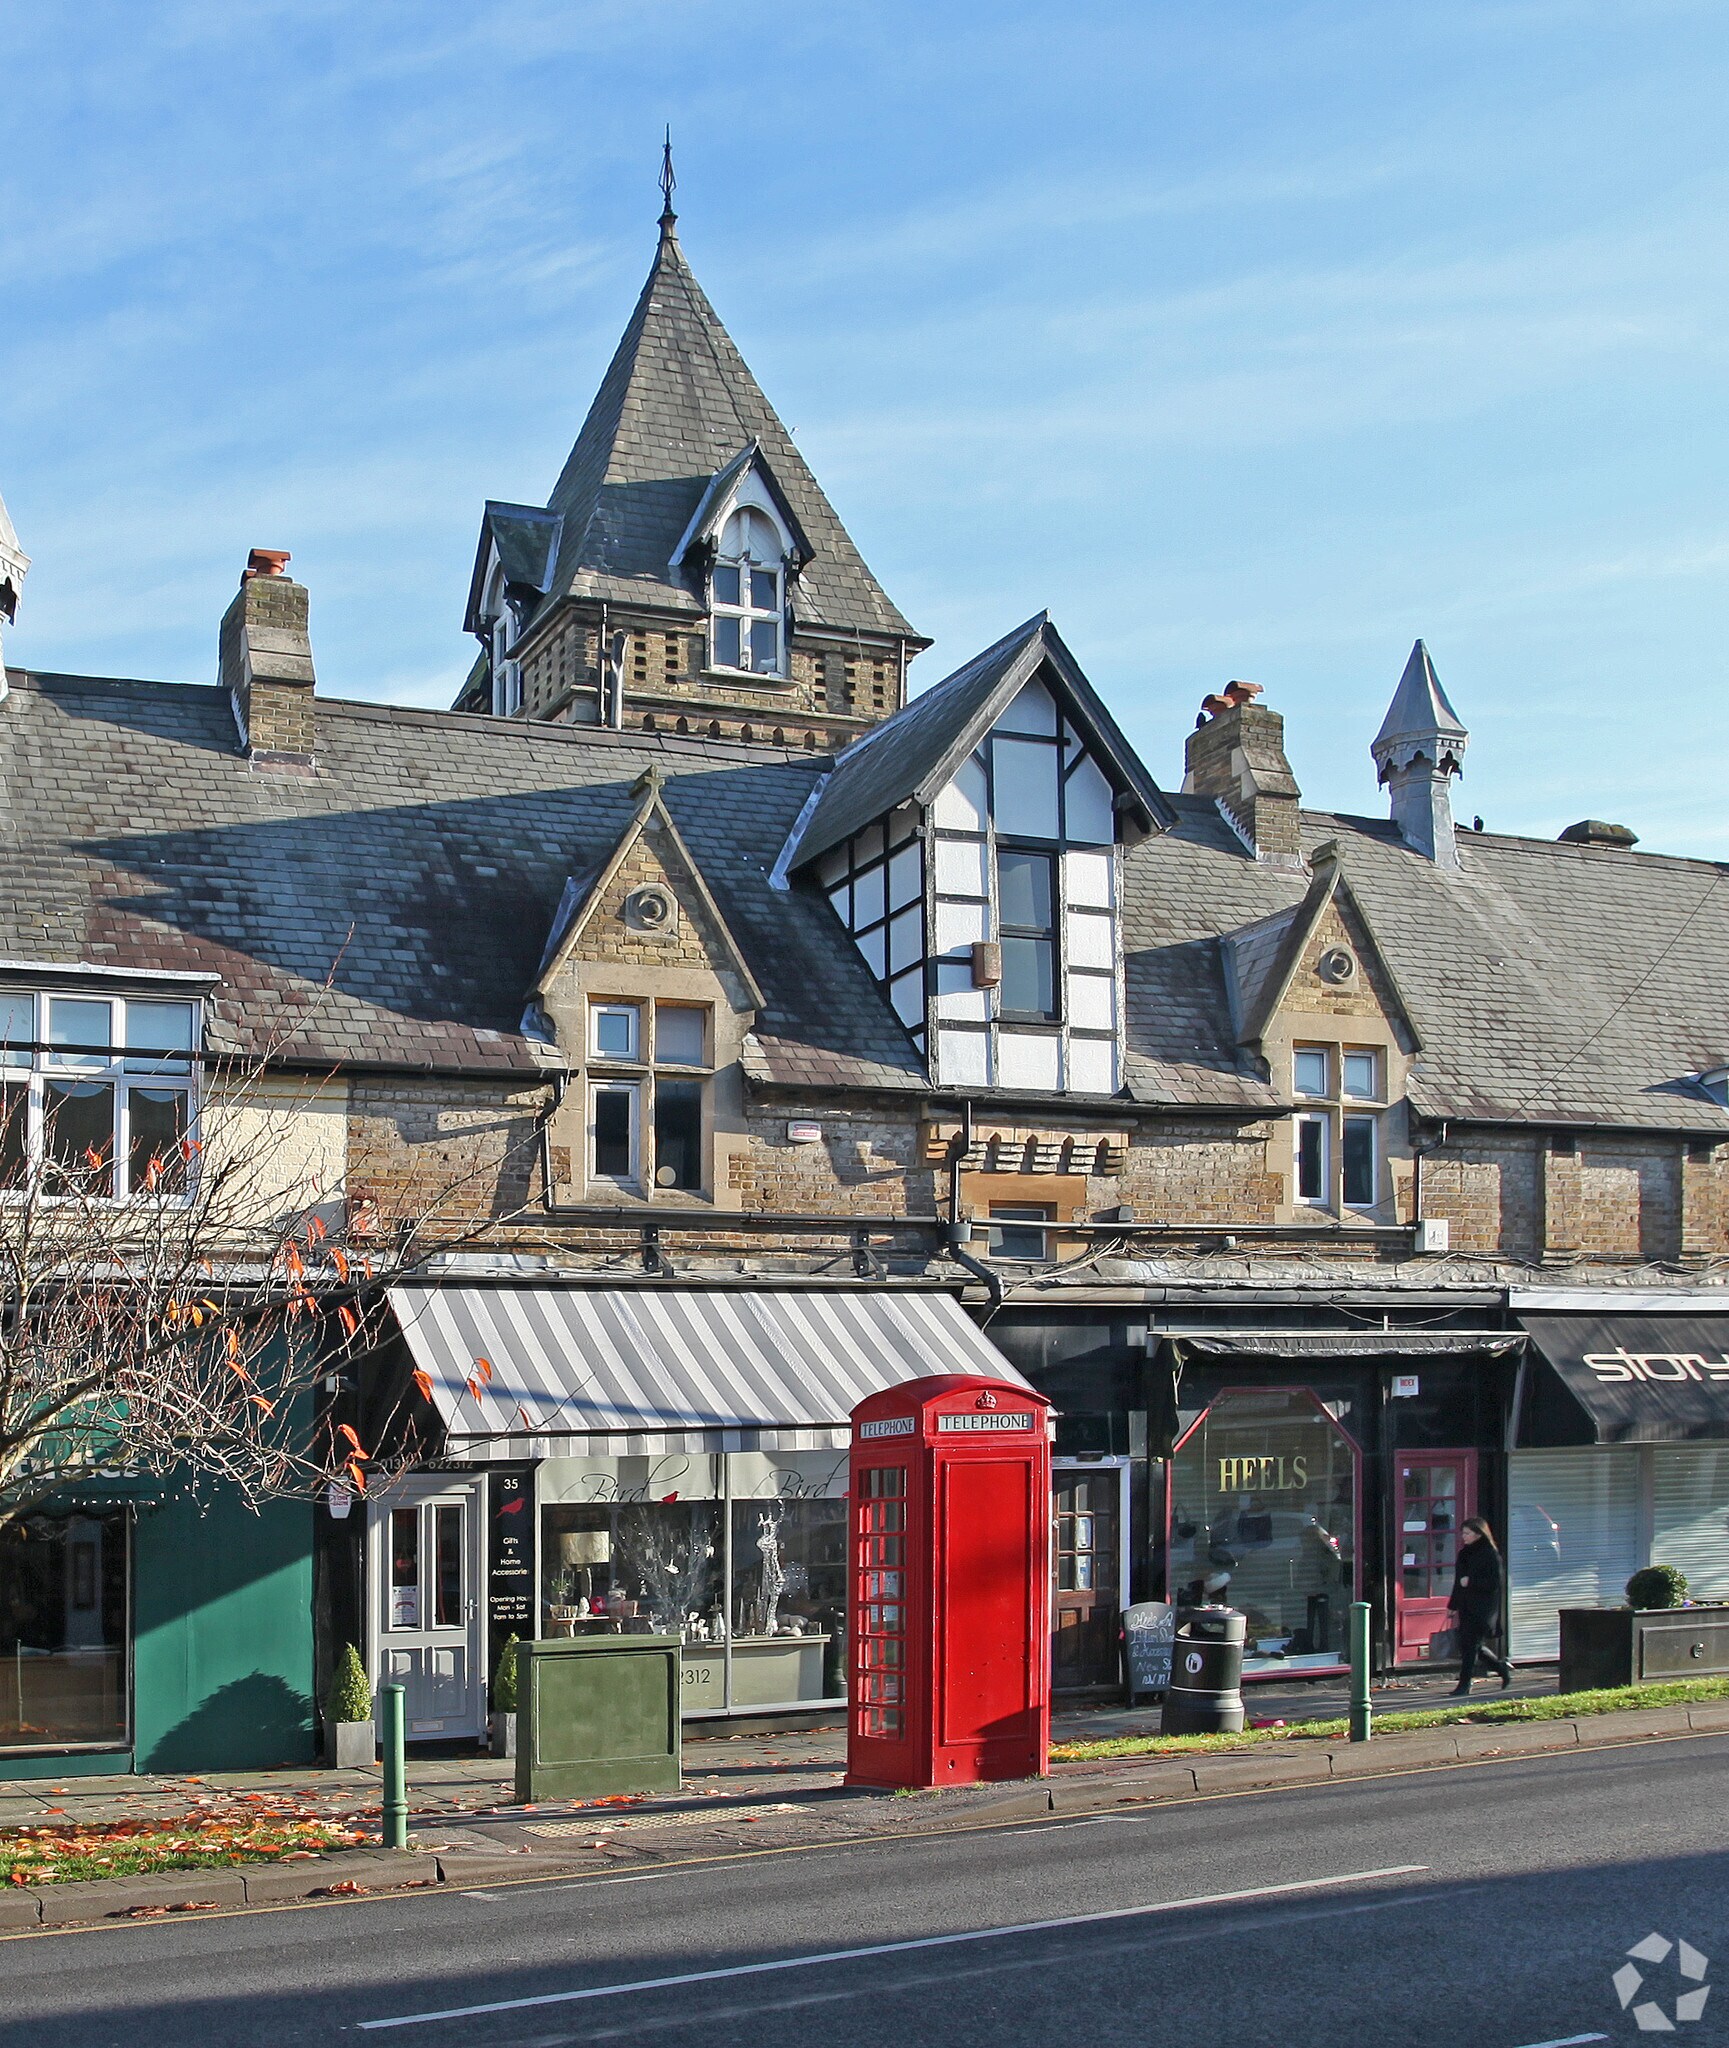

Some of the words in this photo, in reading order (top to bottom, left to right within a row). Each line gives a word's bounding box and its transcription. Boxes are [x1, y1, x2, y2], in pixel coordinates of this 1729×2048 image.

[862, 1417, 914, 1437] TELEPHONE
[942, 1414, 1028, 1430] TELEPHONE
[558, 1454, 690, 1502] Bird
[752, 1454, 849, 1500] Bird
[1218, 1456, 1308, 1492] HEELS
[503, 1478, 519, 1490] 35
[500, 1558, 521, 1566] Home
[491, 1568, 529, 1576] Accessorie
